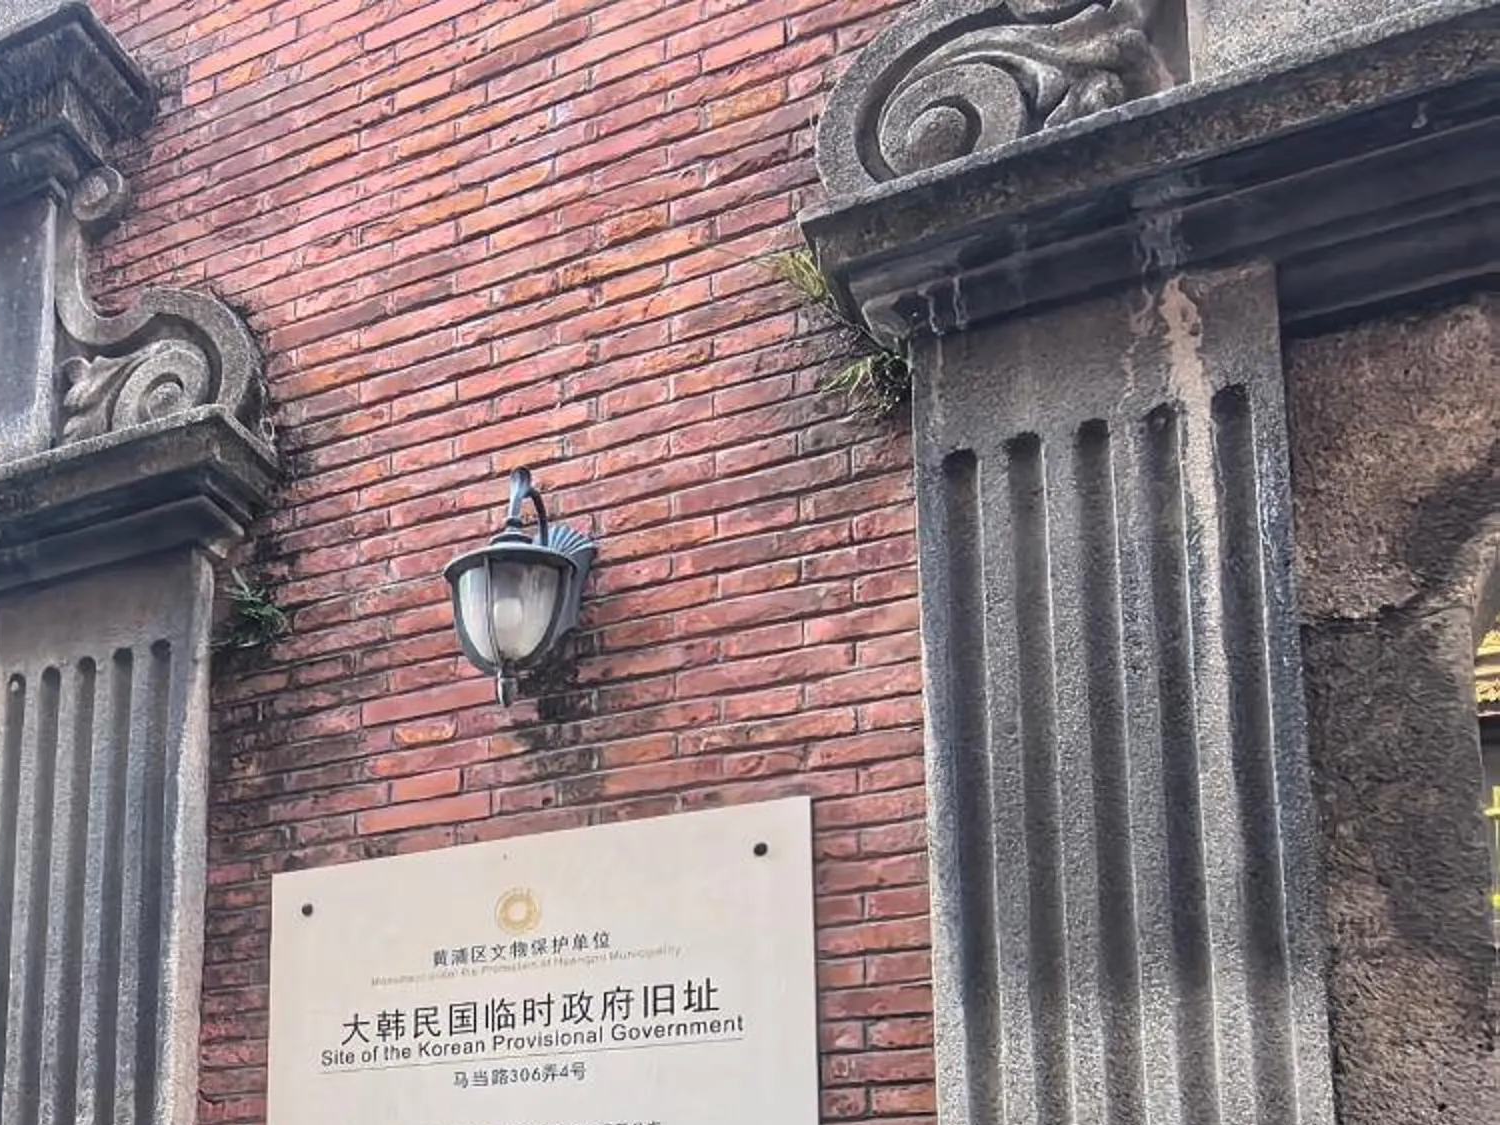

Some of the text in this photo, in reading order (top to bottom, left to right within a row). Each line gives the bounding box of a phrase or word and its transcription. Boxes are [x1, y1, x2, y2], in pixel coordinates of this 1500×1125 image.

[432, 930, 611, 968] 黄浦区文物保护单位
[341, 978, 721, 1046] 大韩民国临时政府旧址
[320, 1014, 744, 1067] Site of the Korean Provisional Government
[453, 1060, 587, 1089] 马当路306弄4号
